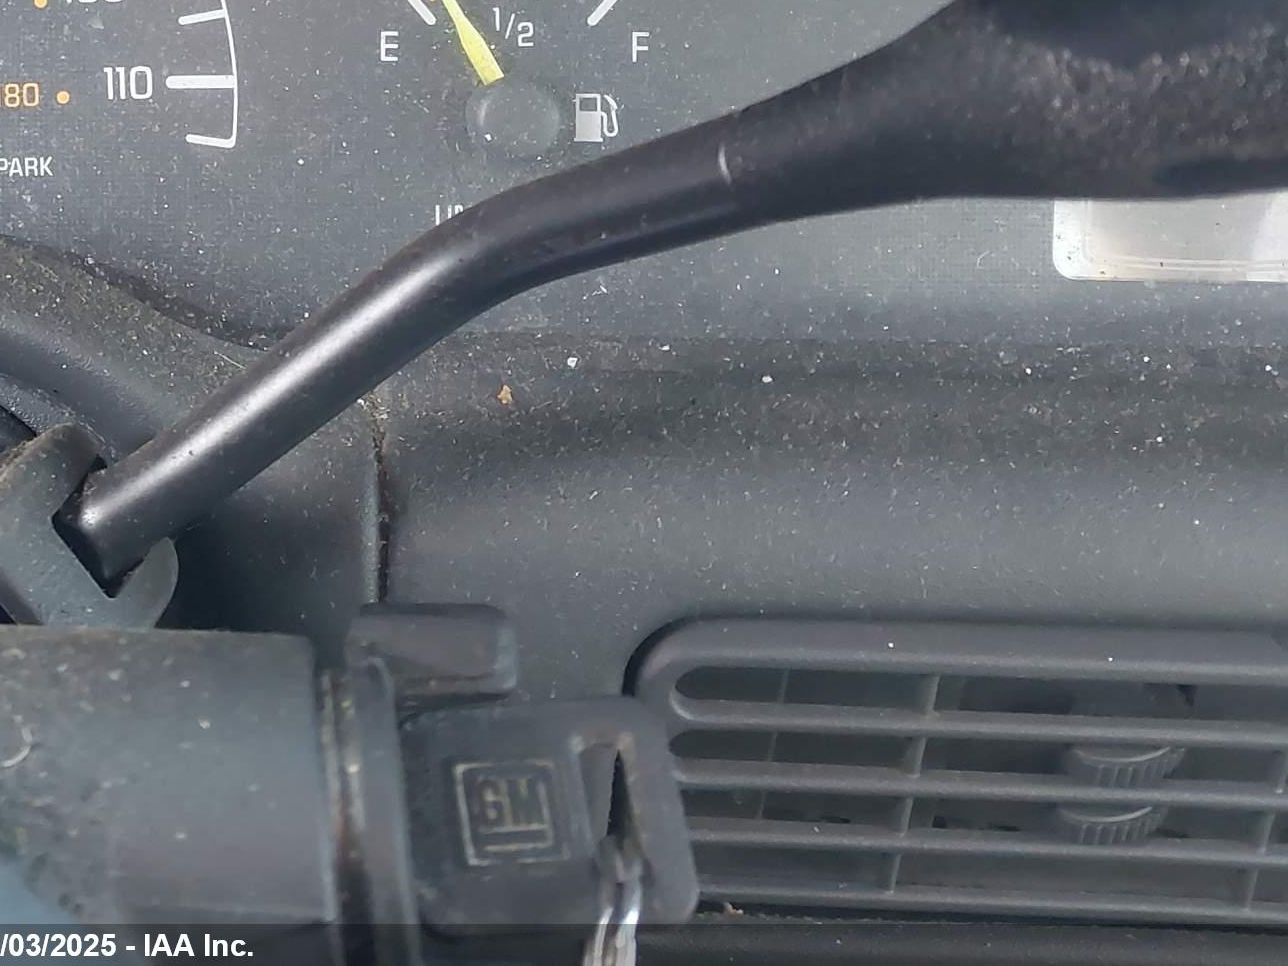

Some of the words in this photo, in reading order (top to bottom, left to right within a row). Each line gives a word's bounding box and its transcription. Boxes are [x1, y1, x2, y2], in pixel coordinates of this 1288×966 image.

[493, 8, 533, 46] 1/2
[381, 31, 398, 61] E
[632, 32, 649, 62] F
[104, 66, 152, 99] 110
